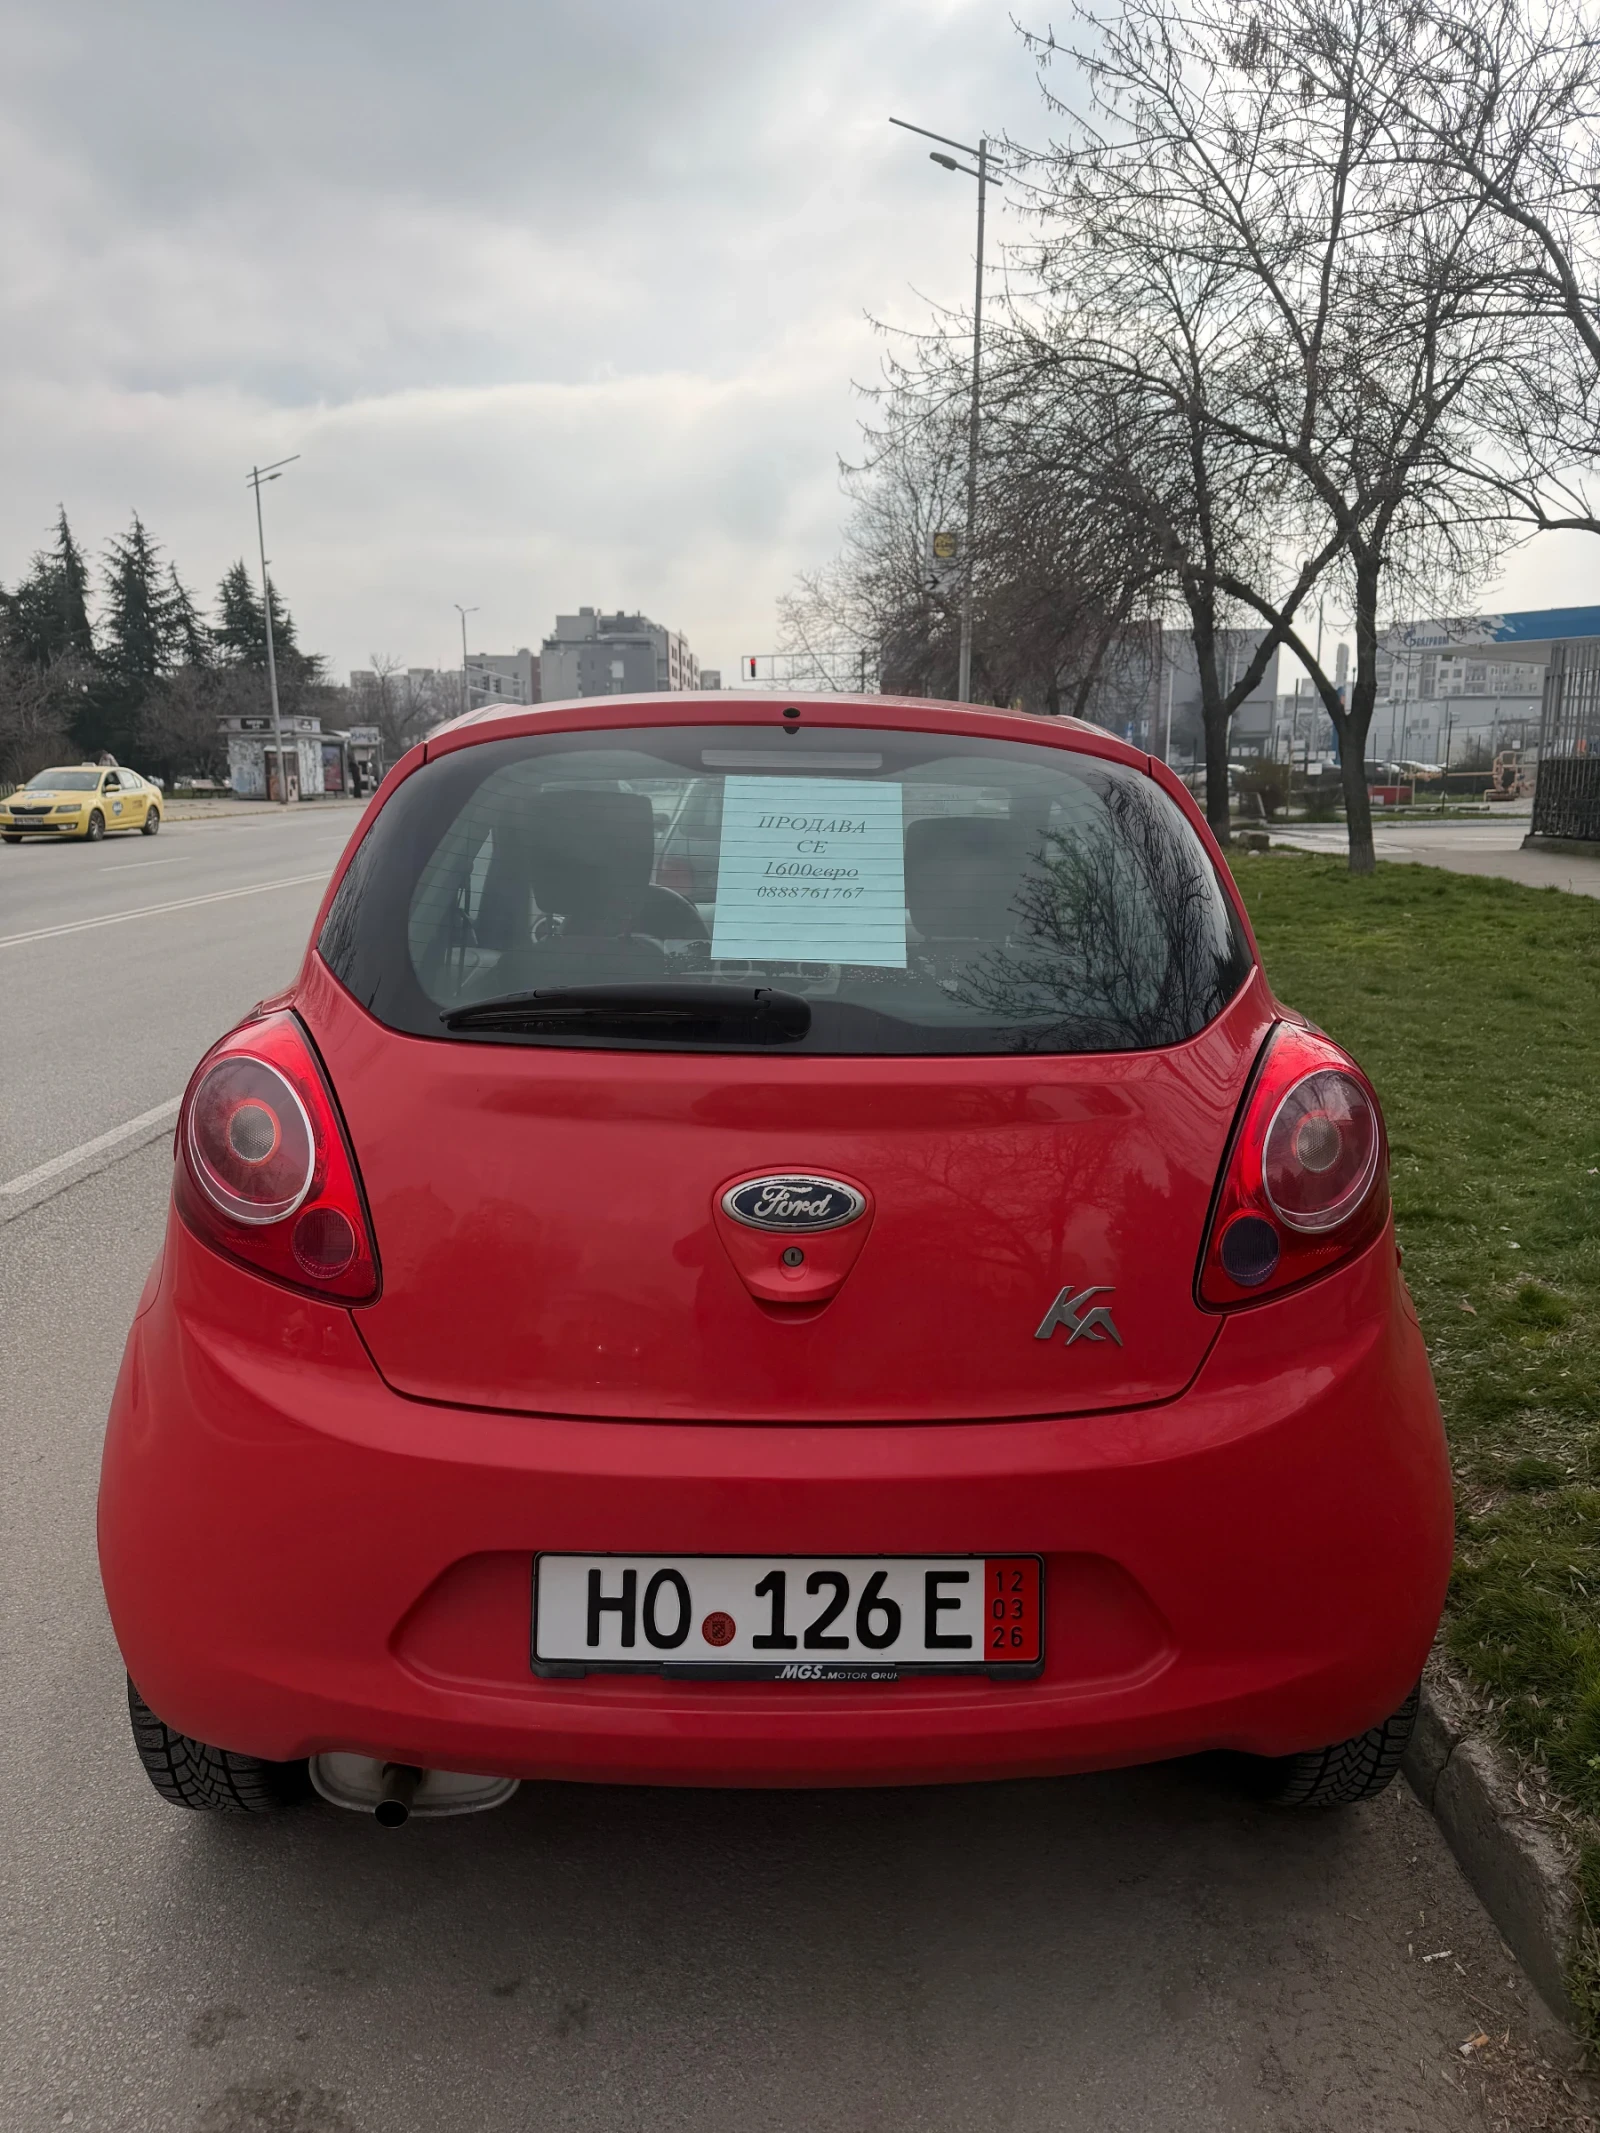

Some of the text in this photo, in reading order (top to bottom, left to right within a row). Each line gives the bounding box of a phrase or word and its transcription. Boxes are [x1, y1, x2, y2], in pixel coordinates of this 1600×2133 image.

[757, 815, 866, 834] ПРОДАВА
[796, 839, 829, 854] СЕ
[763, 861, 860, 881] 1600евро
[757, 886, 865, 899] 0888761767
[753, 1185, 833, 1219] Ford
[995, 1570, 1023, 1592] 12
[587, 1568, 692, 1649] HO
[752, 1570, 902, 1650] 126
[924, 1571, 973, 1649] E
[992, 1598, 1023, 1620] 03
[992, 1626, 1023, 1648] 26
[827, 1671, 868, 1680] MOTOR
